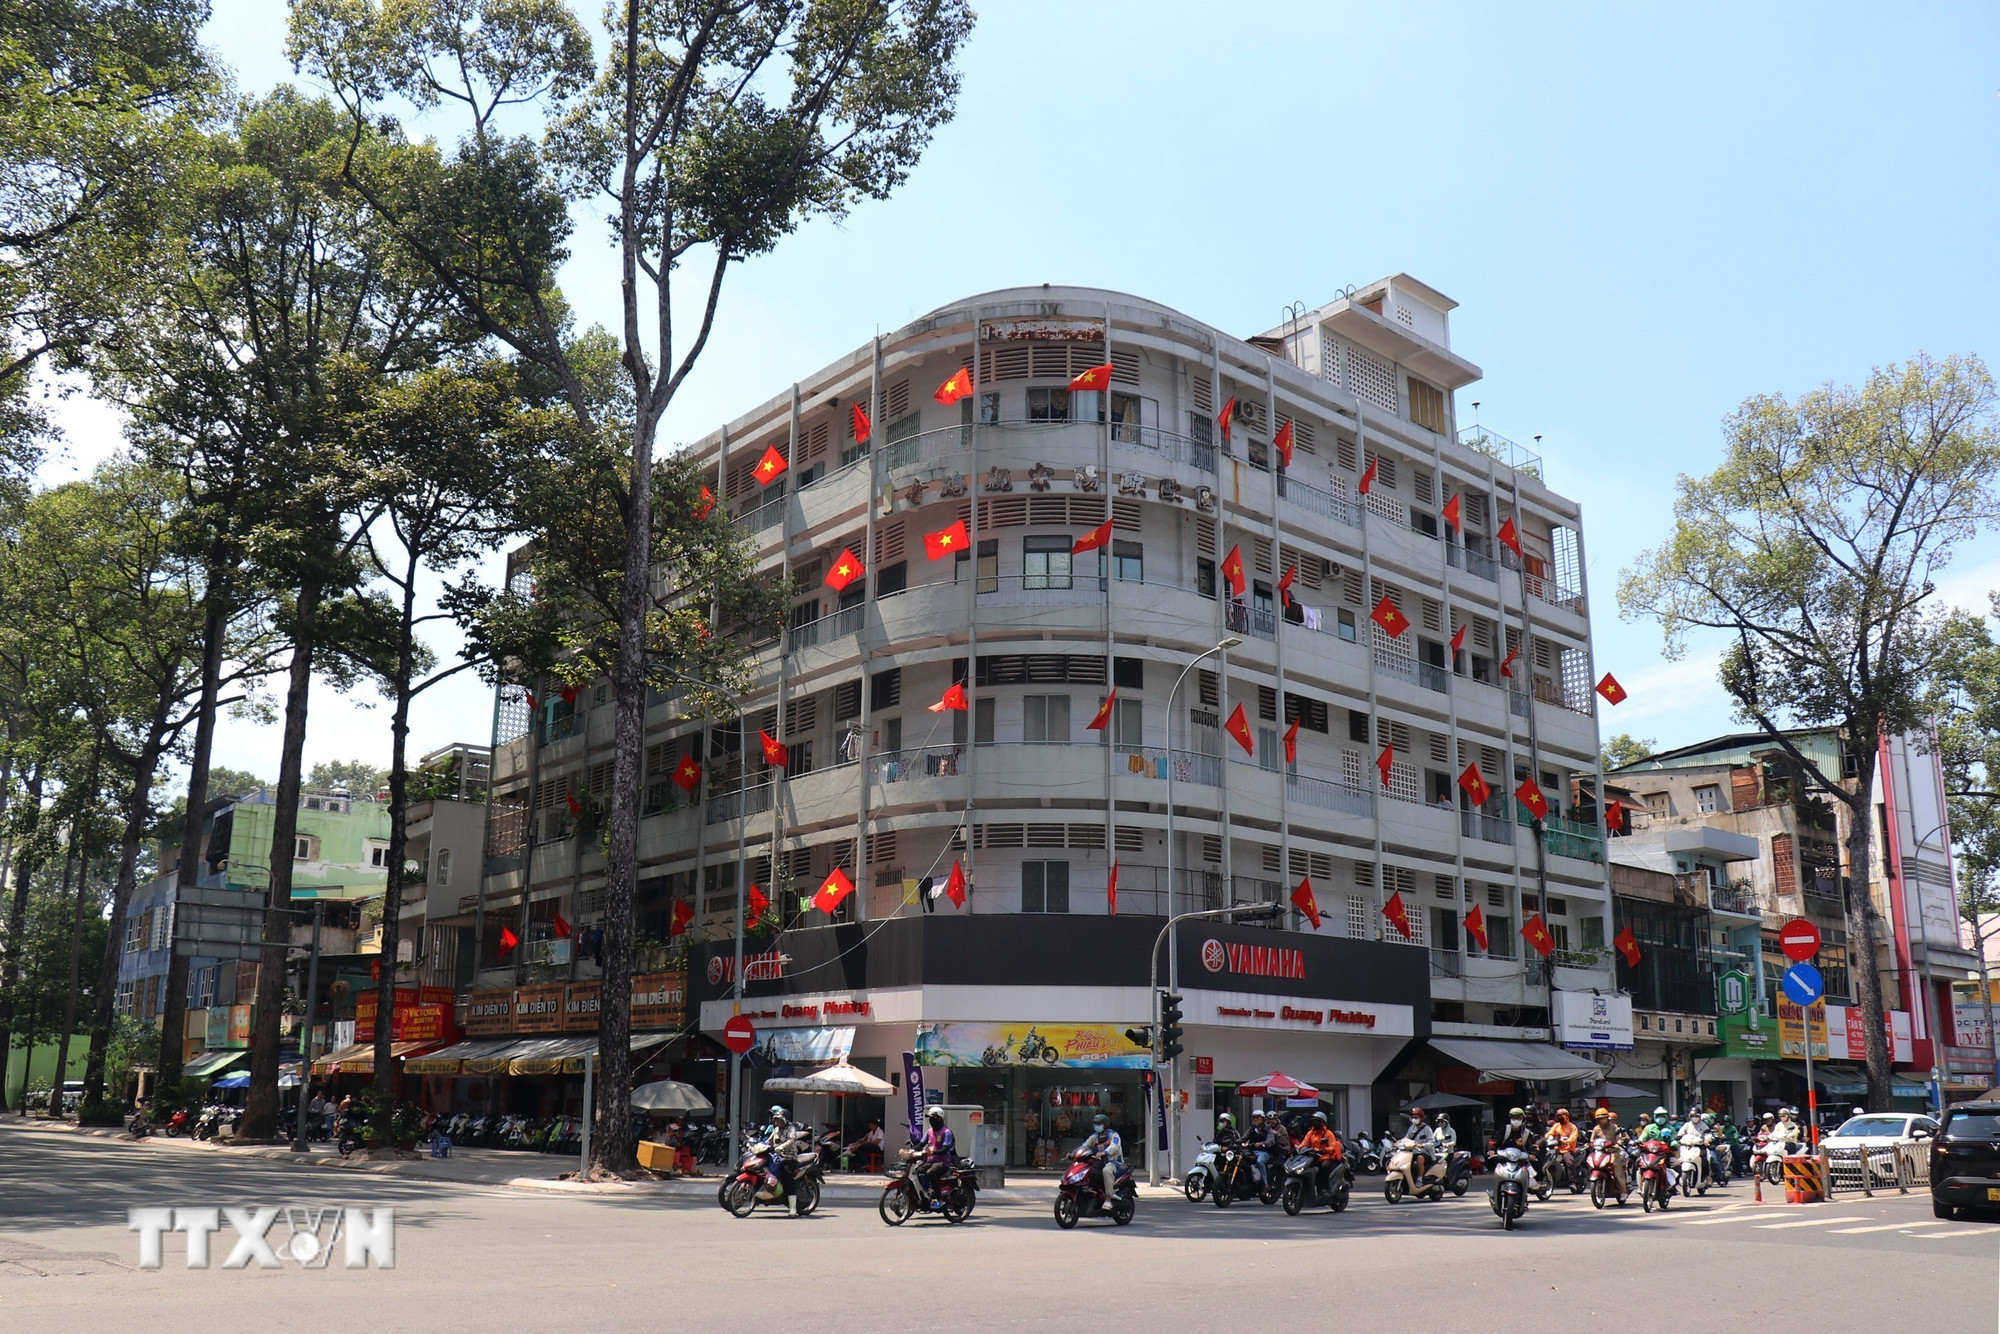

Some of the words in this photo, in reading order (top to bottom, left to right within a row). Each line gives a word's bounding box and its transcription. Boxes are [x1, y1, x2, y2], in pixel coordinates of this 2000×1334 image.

[1226, 942, 1306, 979] YAMAHA
[631, 993, 648, 1006] KIM
[409, 1007, 441, 1018] VICTORIA
[472, 1005, 484, 1016] KIM
[516, 1003, 529, 1015] KIM
[566, 1000, 580, 1013] KIM
[781, 1004, 818, 1020] Quang
[1281, 1006, 1323, 1025] Quang
[1080, 1053, 1108, 1062] PG-1
[912, 1083, 924, 1126] YAMAHA
